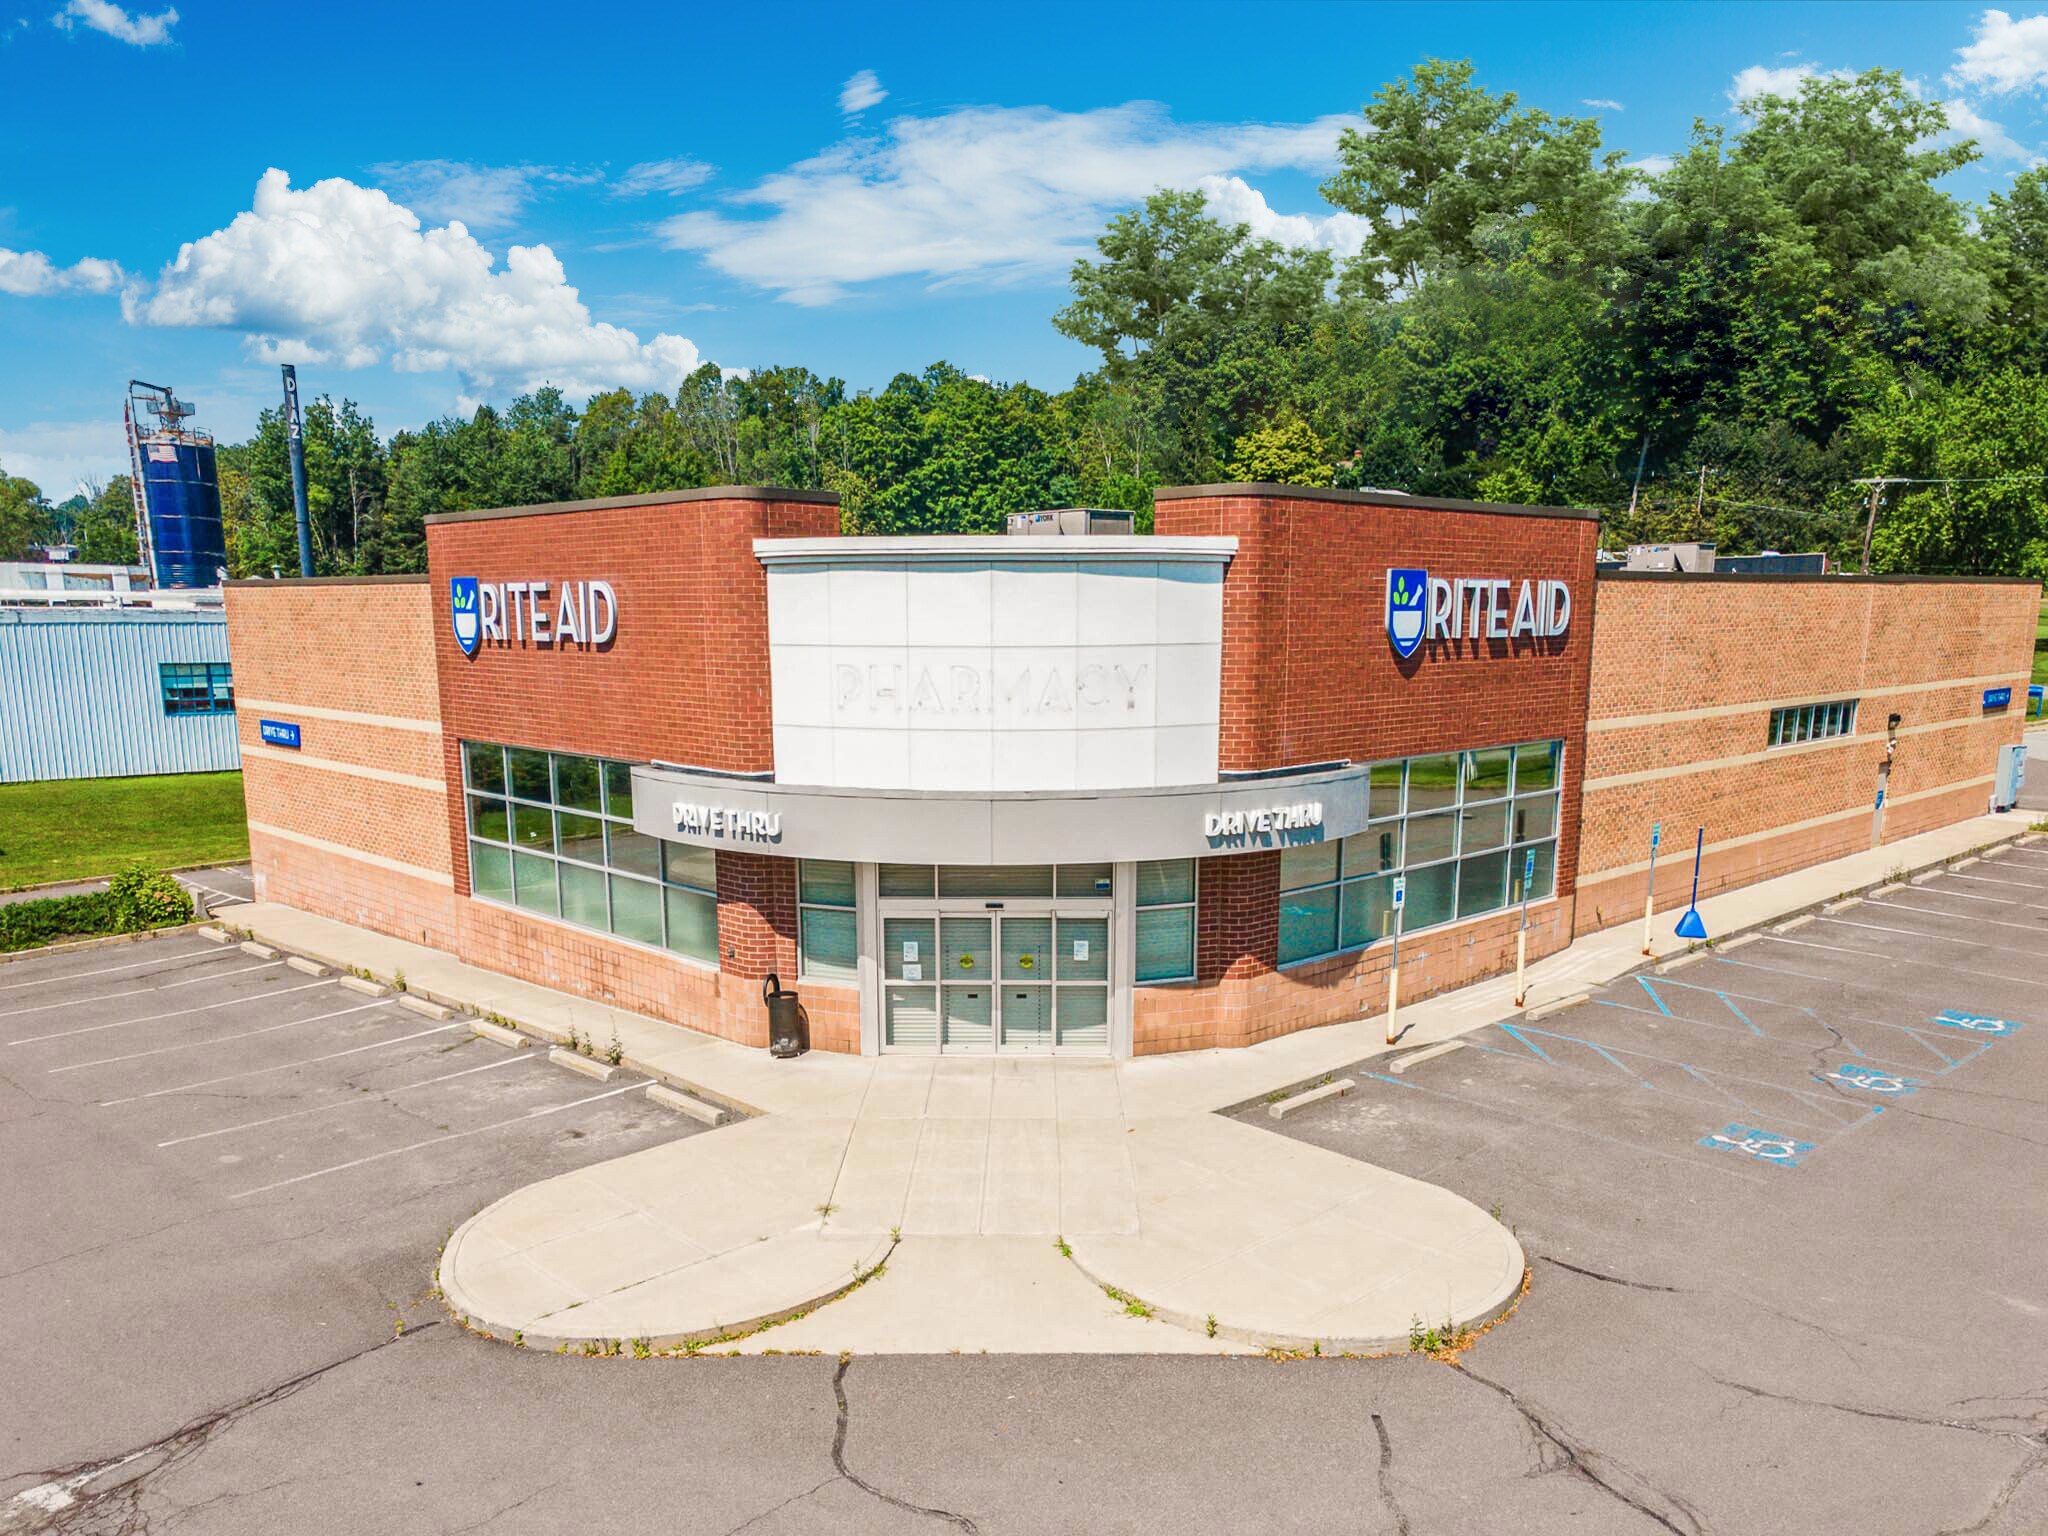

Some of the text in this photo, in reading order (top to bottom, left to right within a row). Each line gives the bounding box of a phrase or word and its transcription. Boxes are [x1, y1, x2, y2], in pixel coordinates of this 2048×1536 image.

[286, 377, 300, 438] DIAZ
[479, 580, 618, 644] RITE AID
[1426, 577, 1571, 639] RITE AID
[836, 663, 1149, 713] PHARMACY
[672, 802, 782, 836] DRIVE THRU
[1205, 801, 1323, 836] DRIVE THRU
